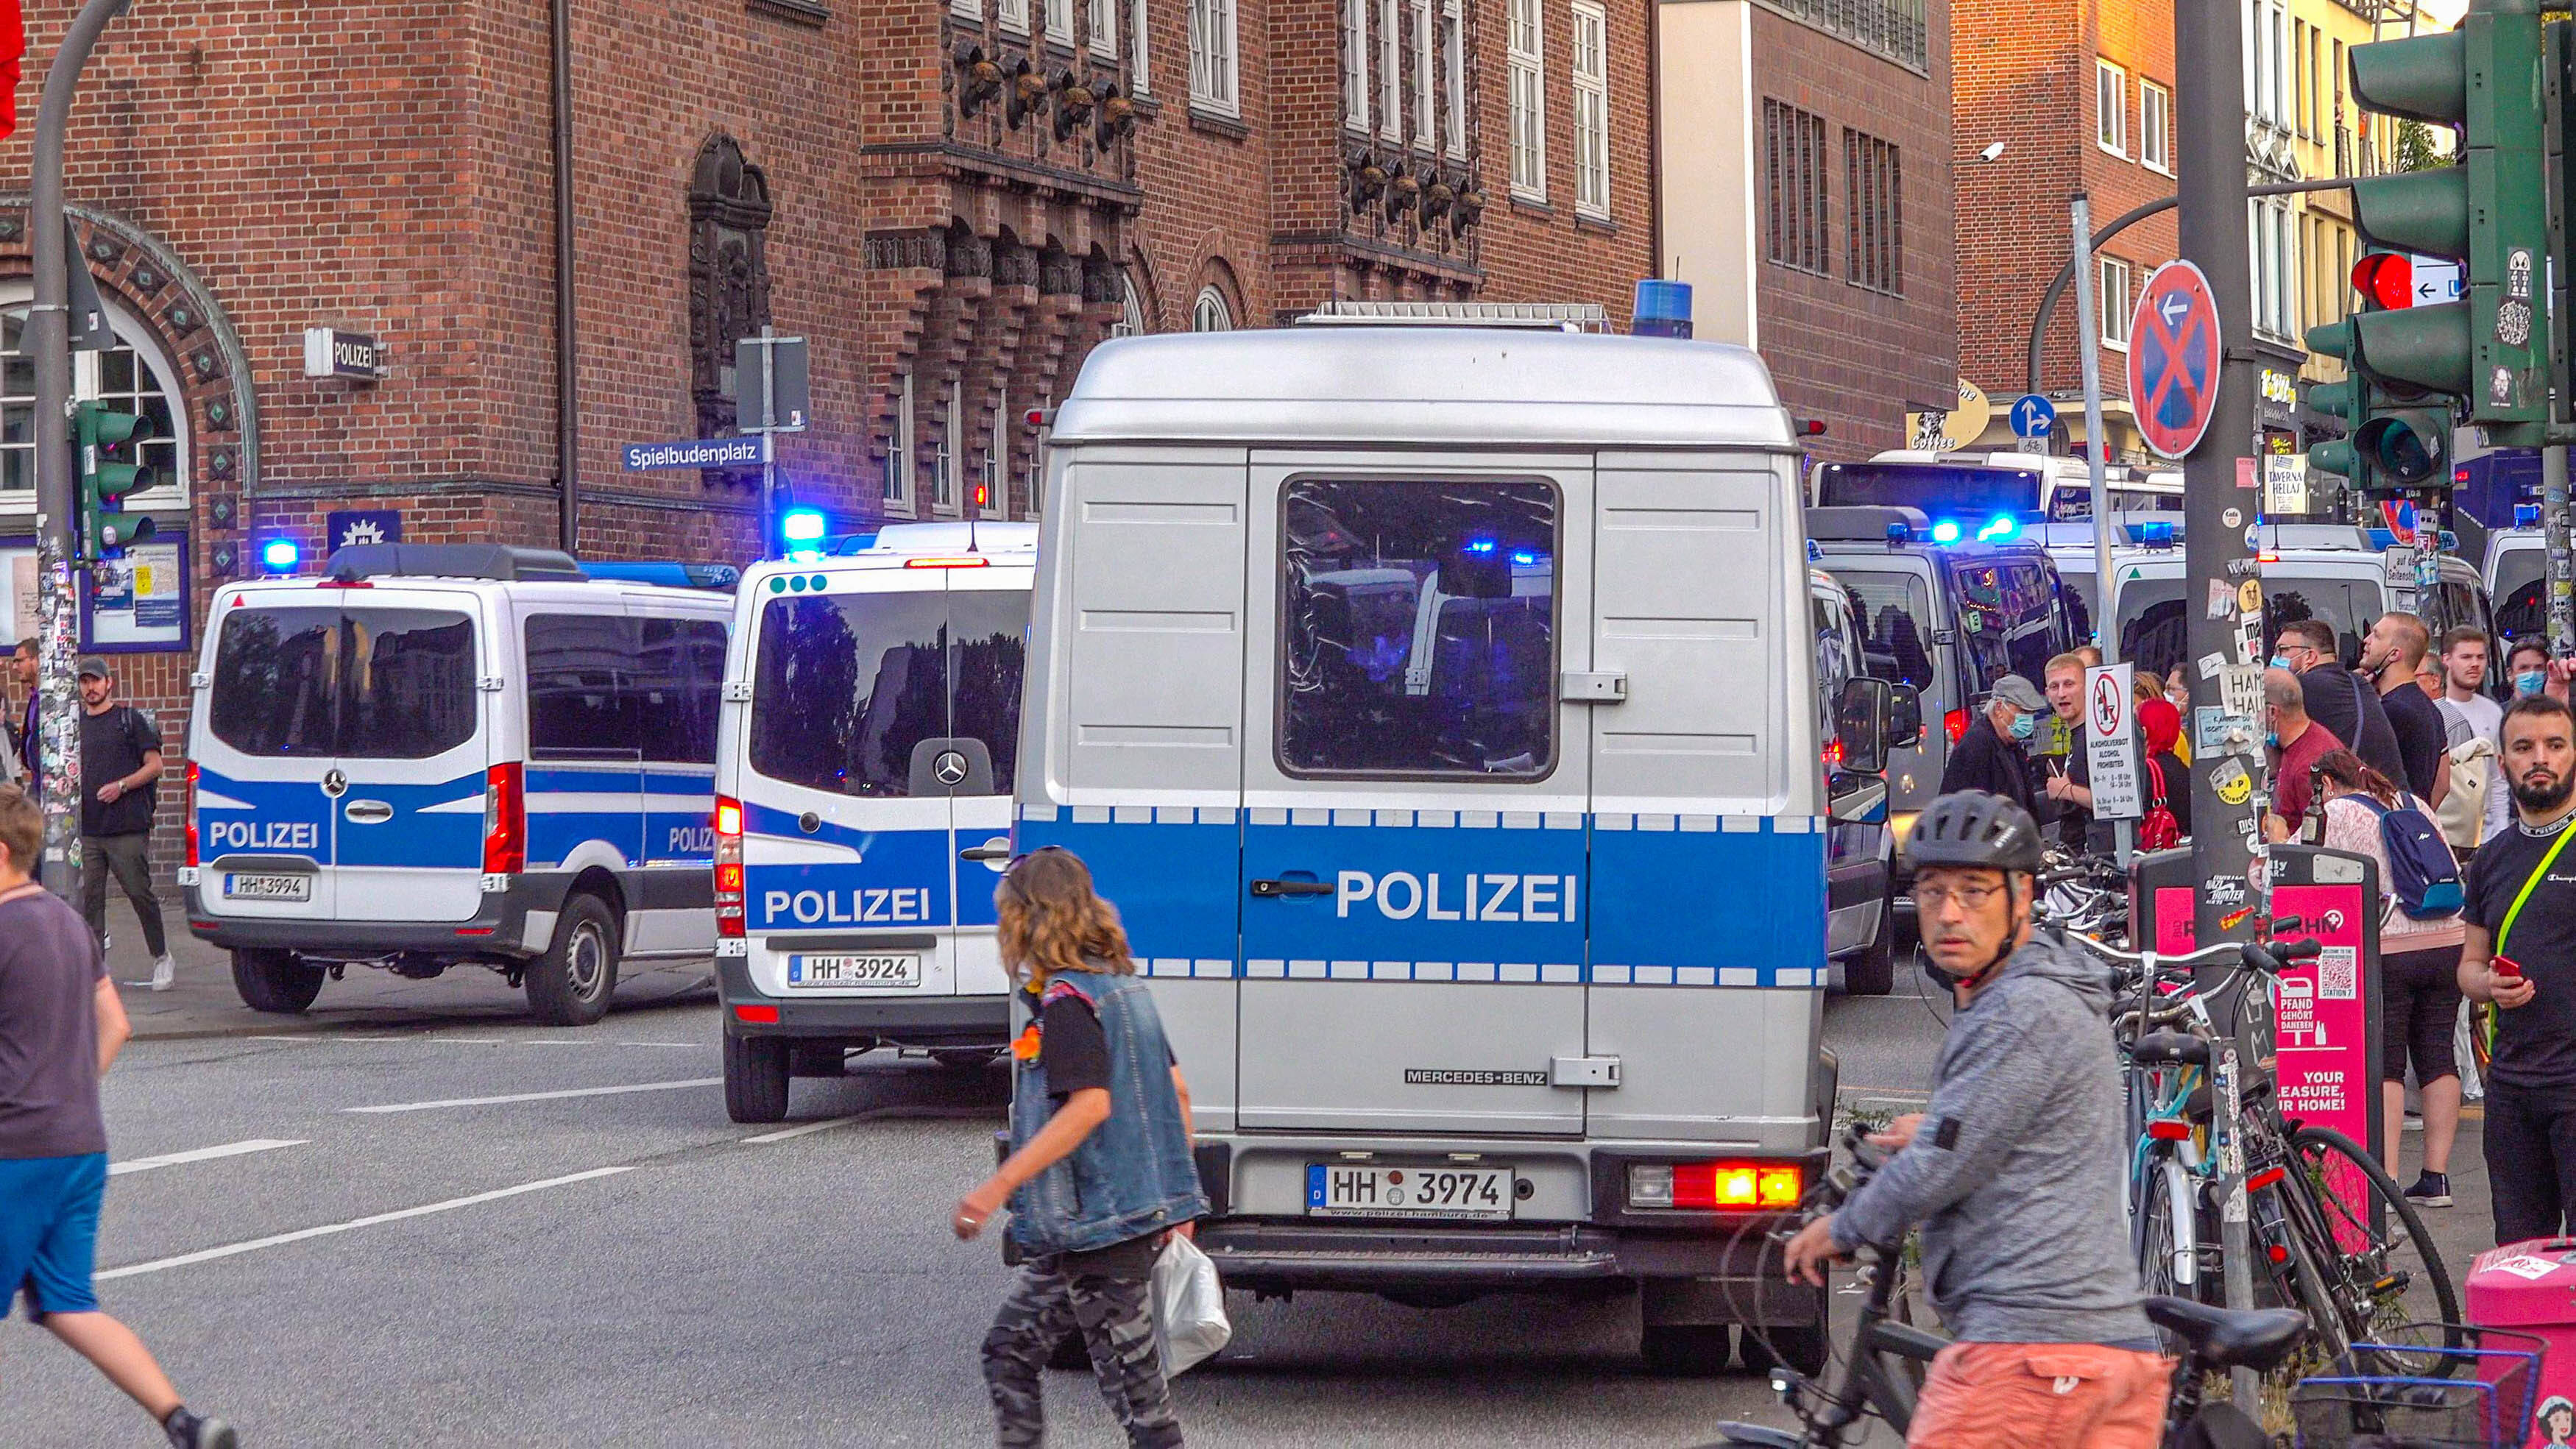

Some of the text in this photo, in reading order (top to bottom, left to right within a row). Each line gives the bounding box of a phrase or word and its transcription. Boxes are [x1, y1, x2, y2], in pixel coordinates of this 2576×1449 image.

[334, 341, 372, 369] POLIZEI
[1911, 433, 1956, 451] Coffee
[629, 442, 757, 471] Spielbudenplatz
[2268, 471, 2303, 483] TAVERNA
[2272, 483, 2301, 495] HELLAS
[2396, 556, 2407, 566] auf
[2090, 738, 2129, 748] ALKOHOLVERBOT
[2098, 750, 2120, 759] ALCOHOL
[2096, 759, 2125, 769] PROHIBITED
[210, 822, 319, 849] POLIZEI
[238, 876, 301, 894] HH 3994
[1337, 870, 1577, 923] POLIZEI
[2212, 890, 2246, 903] HUNTER
[765, 888, 930, 924] POLIZEI
[812, 958, 841, 979] HH
[854, 958, 908, 979] 3924
[2322, 989, 2346, 997] STATION
[2280, 998, 2313, 1010] PFAND
[2281, 1009, 2313, 1021] GEHÖRT
[2282, 1021, 2314, 1030] DANEBEN
[1406, 1069, 1546, 1085] MERCEDES-BENZ
[2303, 1071, 2344, 1083] YOUR
[2276, 1085, 2345, 1099] EASURE,
[2298, 1099, 2346, 1111] HOME!
[1313, 1170, 1499, 1206] D HH 3974
